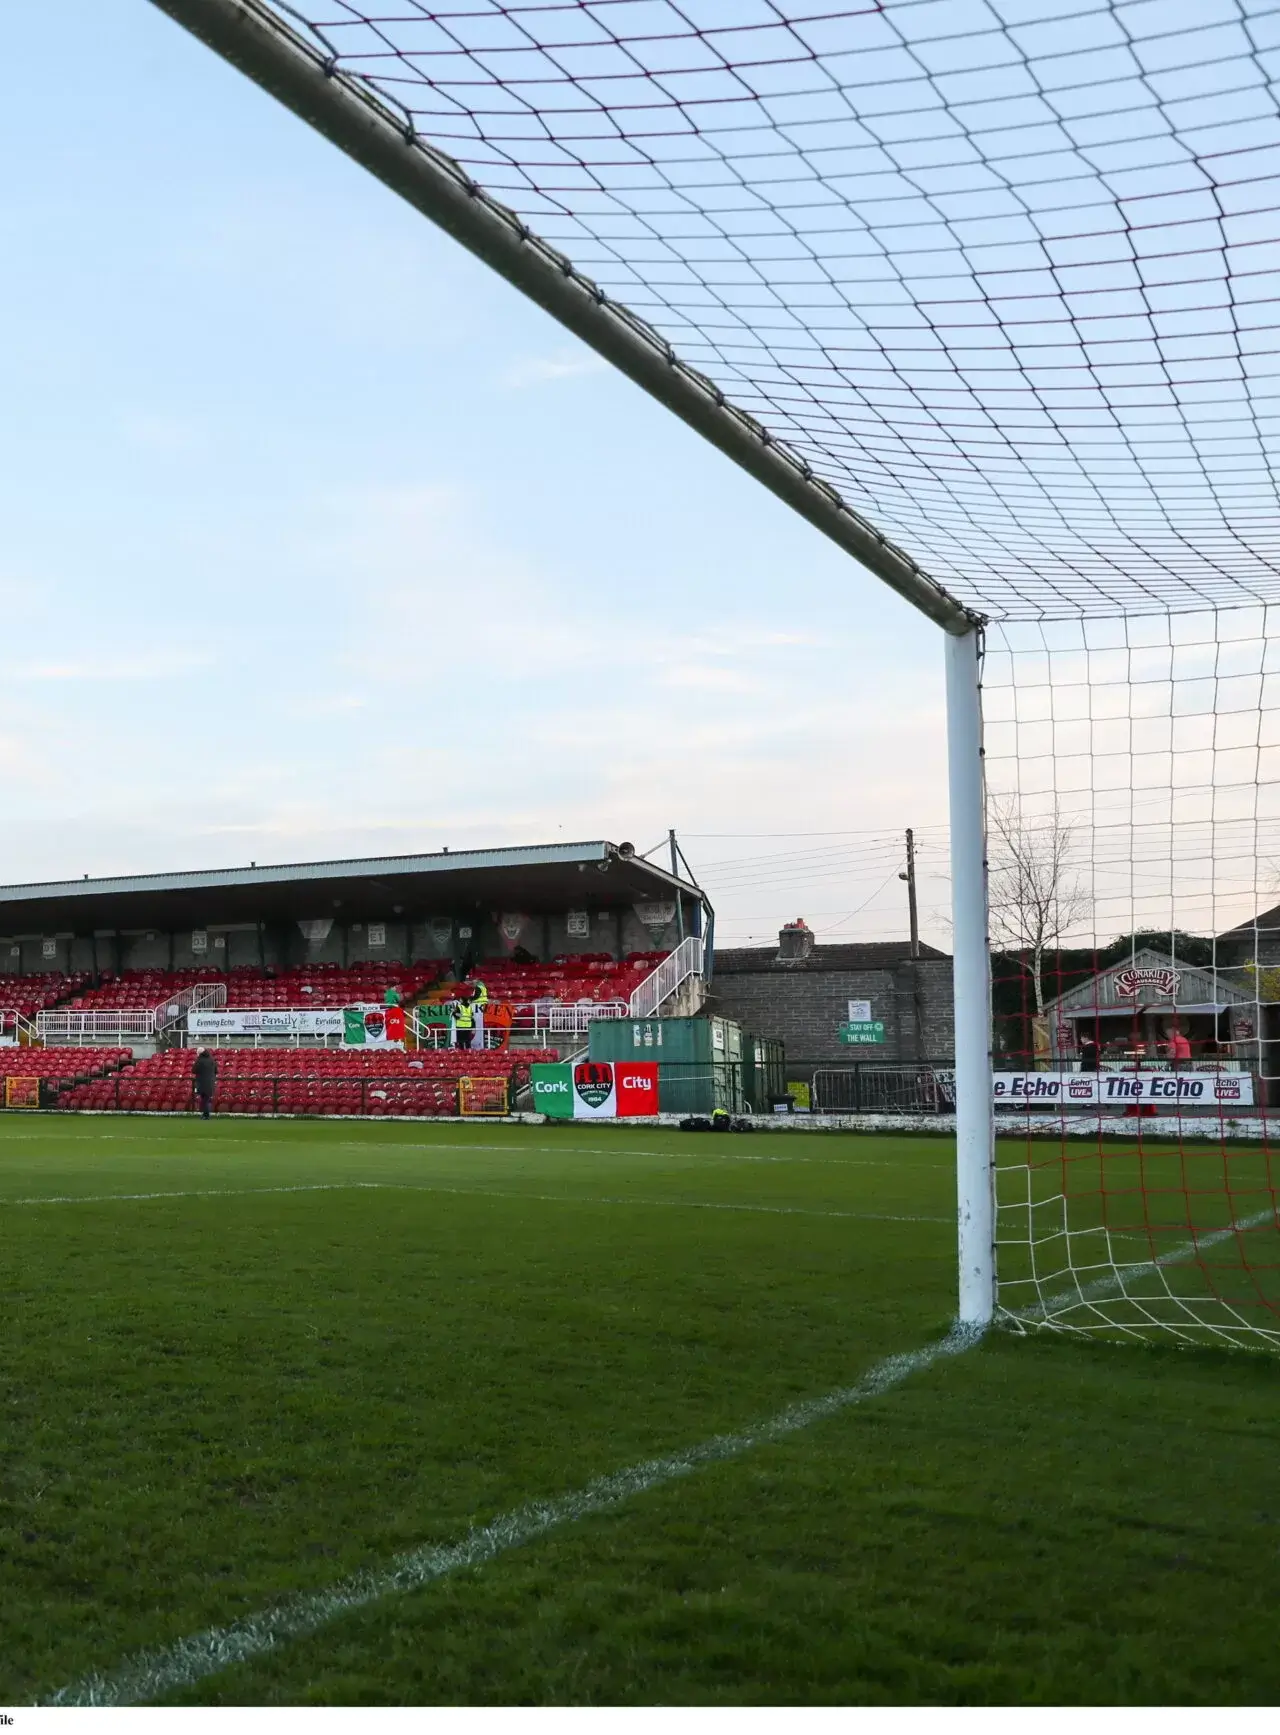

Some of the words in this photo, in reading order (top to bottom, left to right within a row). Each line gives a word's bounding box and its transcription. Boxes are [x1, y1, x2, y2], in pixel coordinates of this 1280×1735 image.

[1121, 969, 1173, 985] CLONAKILTY
[261, 1013, 298, 1029] Family
[850, 1023, 862, 1031] STAY
[862, 1023, 874, 1031] OFF
[847, 1034, 860, 1042] THE
[860, 1034, 877, 1042] WALL
[535, 1081, 568, 1093] Cork
[622, 1076, 652, 1091] City
[1010, 1078, 1059, 1096] Echo
[1070, 1078, 1091, 1087] Echo
[1105, 1077, 1144, 1096] The
[1149, 1077, 1204, 1097] Echo
[1215, 1079, 1238, 1087] Echo
